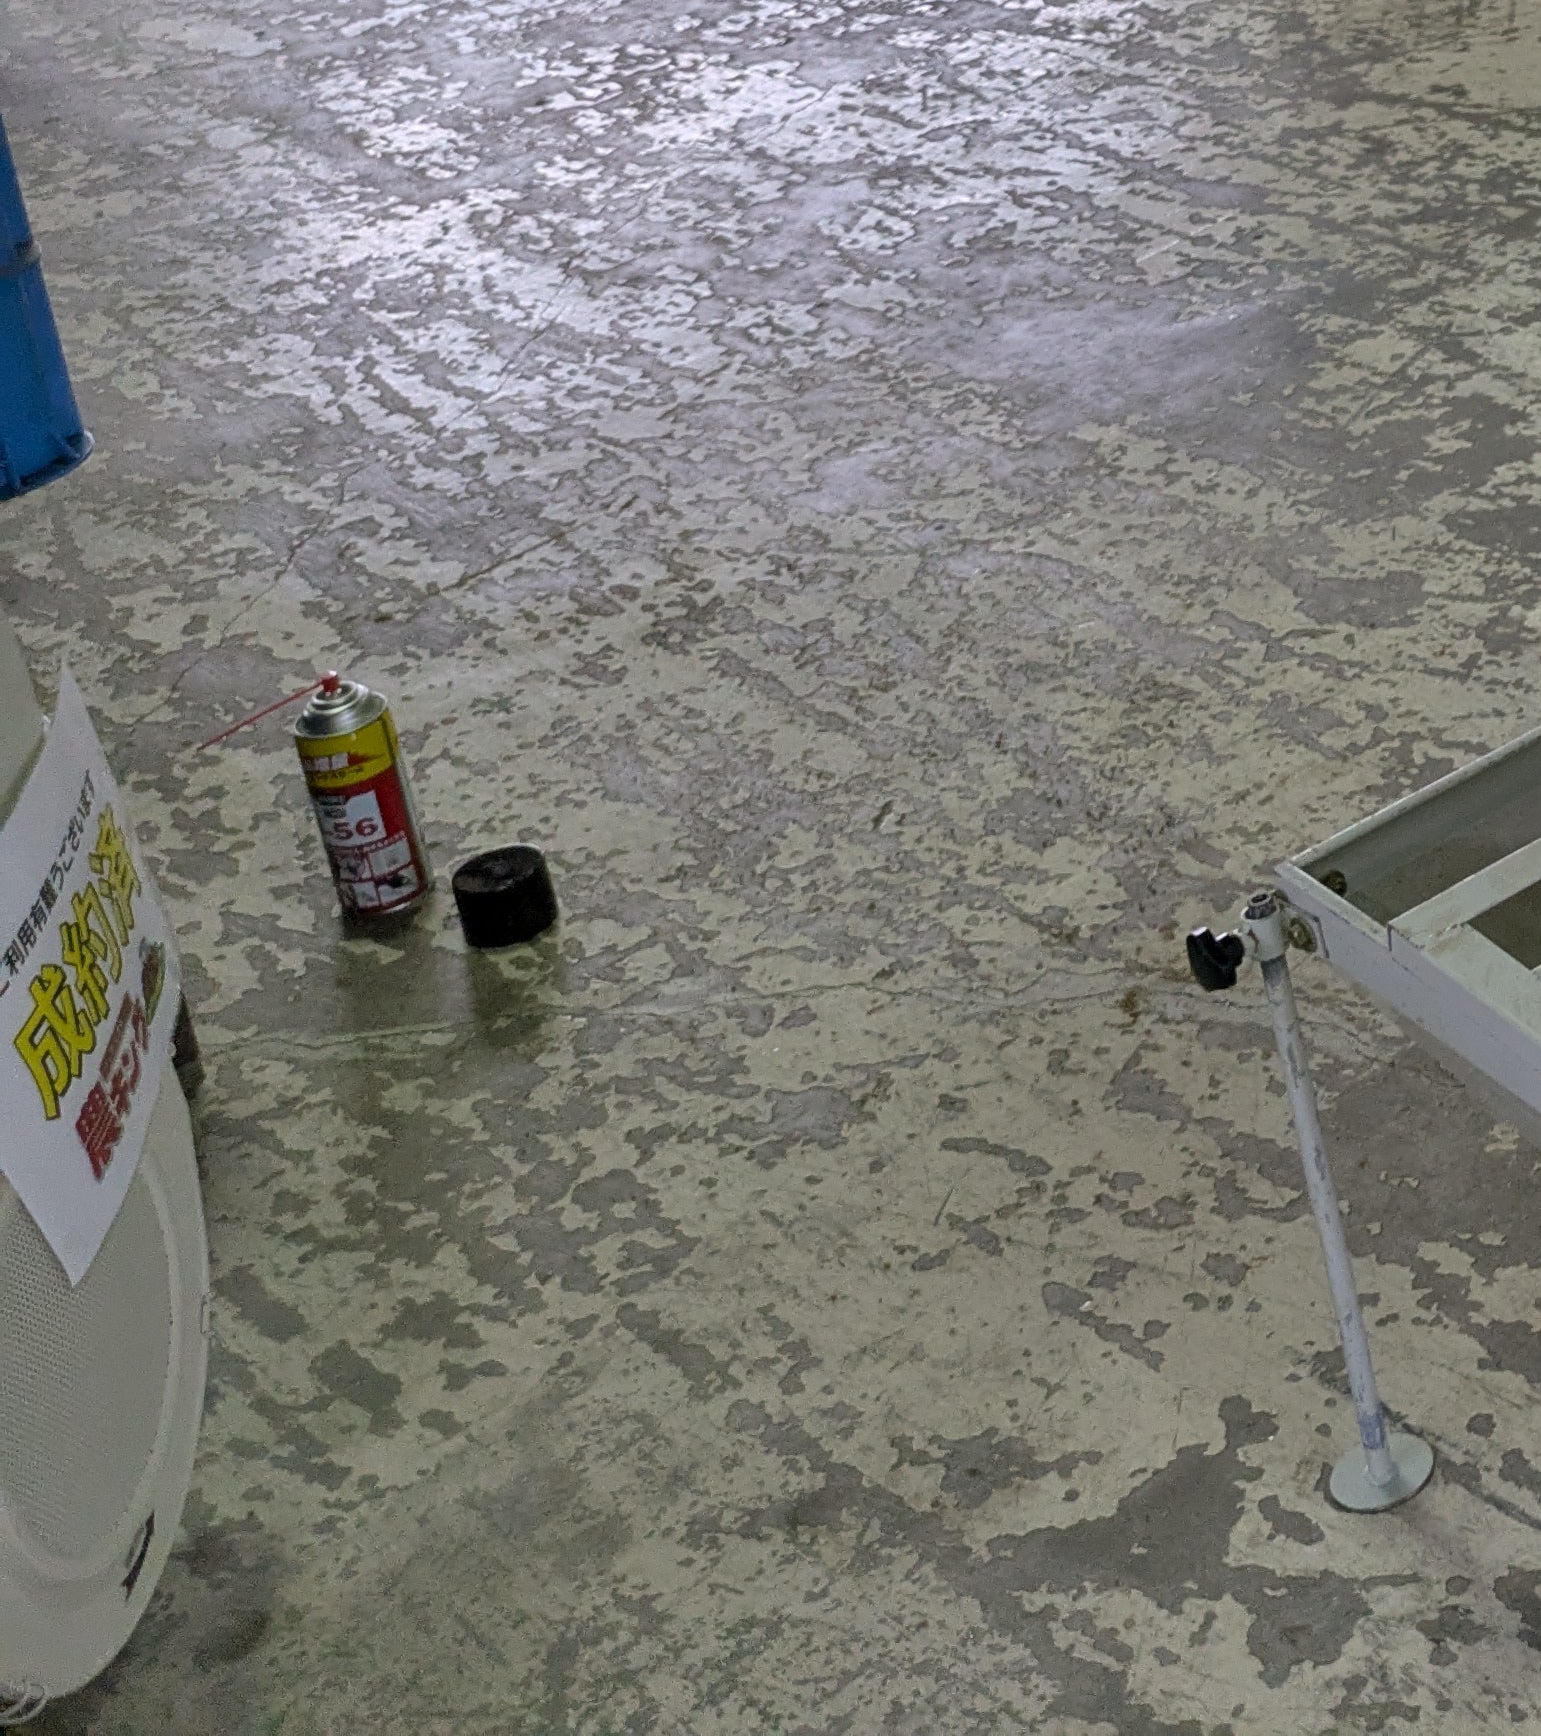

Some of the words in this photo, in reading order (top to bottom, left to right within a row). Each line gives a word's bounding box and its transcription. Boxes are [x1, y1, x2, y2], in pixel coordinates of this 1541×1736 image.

[0, 768, 96, 997] 利用有難うございます
[13, 801, 142, 1122] 成約済
